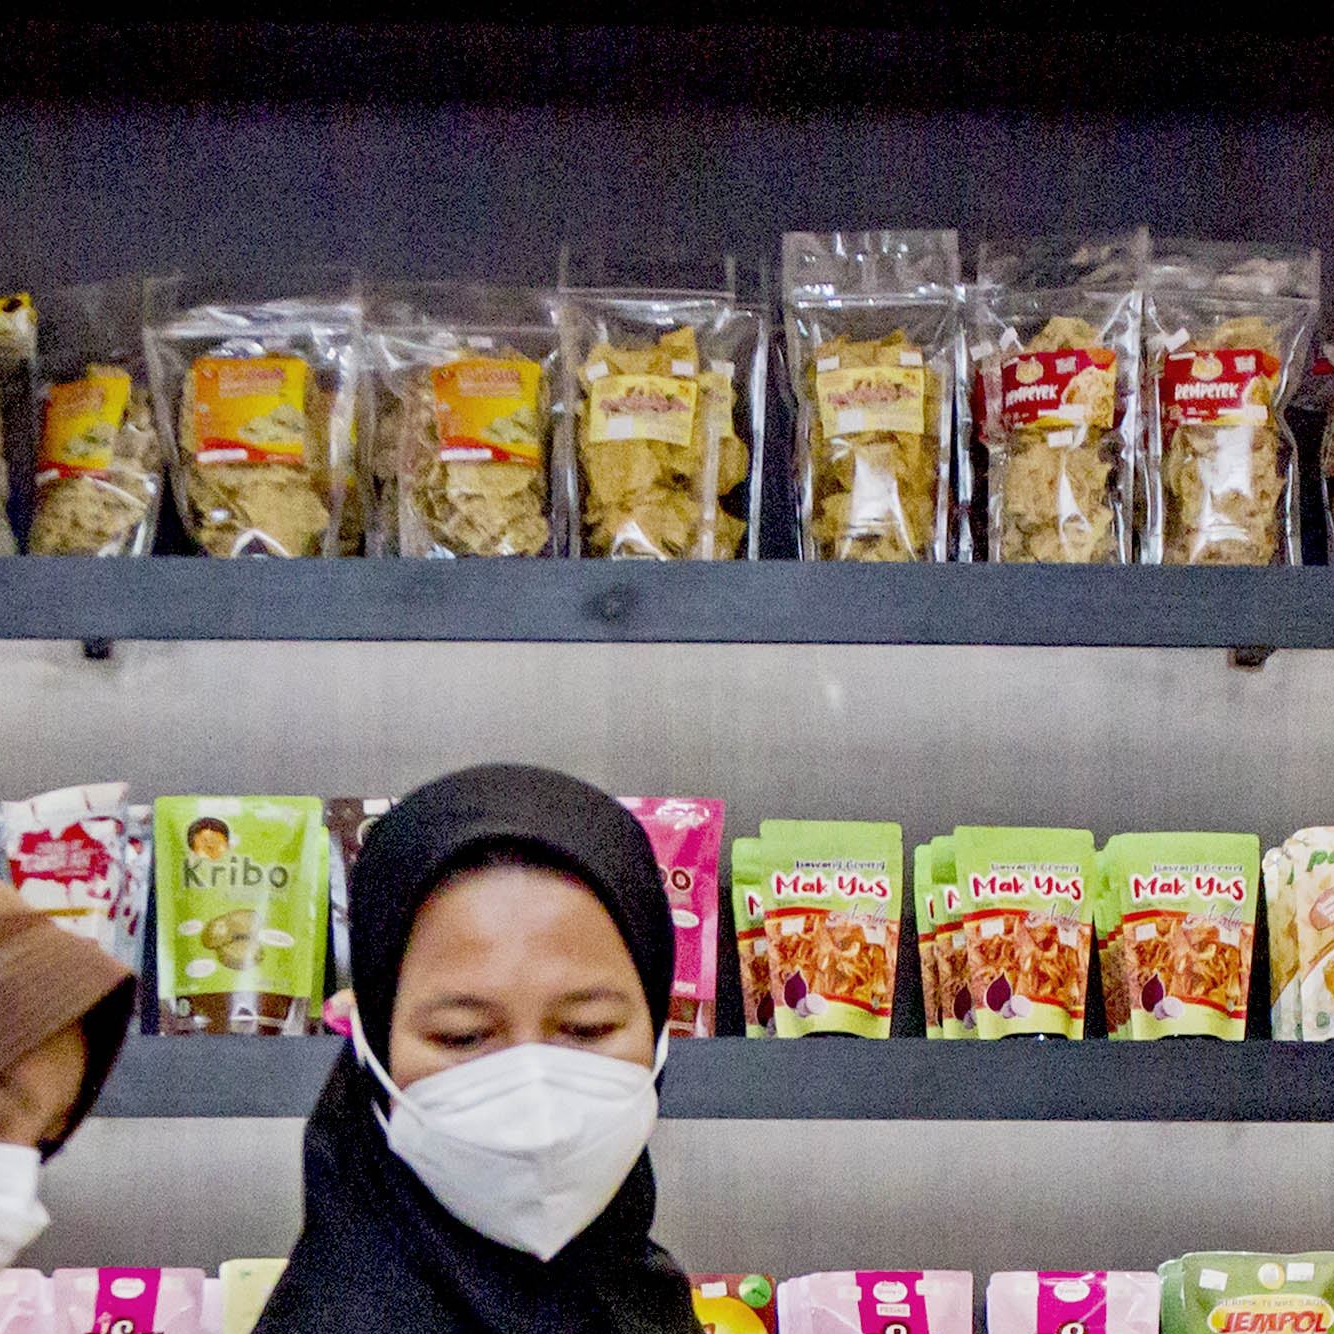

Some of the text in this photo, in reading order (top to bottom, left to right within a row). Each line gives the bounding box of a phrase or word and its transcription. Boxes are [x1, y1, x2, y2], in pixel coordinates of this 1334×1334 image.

[183, 856, 288, 888] Kribo
[776, 875, 888, 897] Mak Yus
[972, 876, 1081, 900] Mak Yus
[1134, 877, 1244, 900] Mak Yus
[1221, 1311, 1326, 1333] JEMPOL
